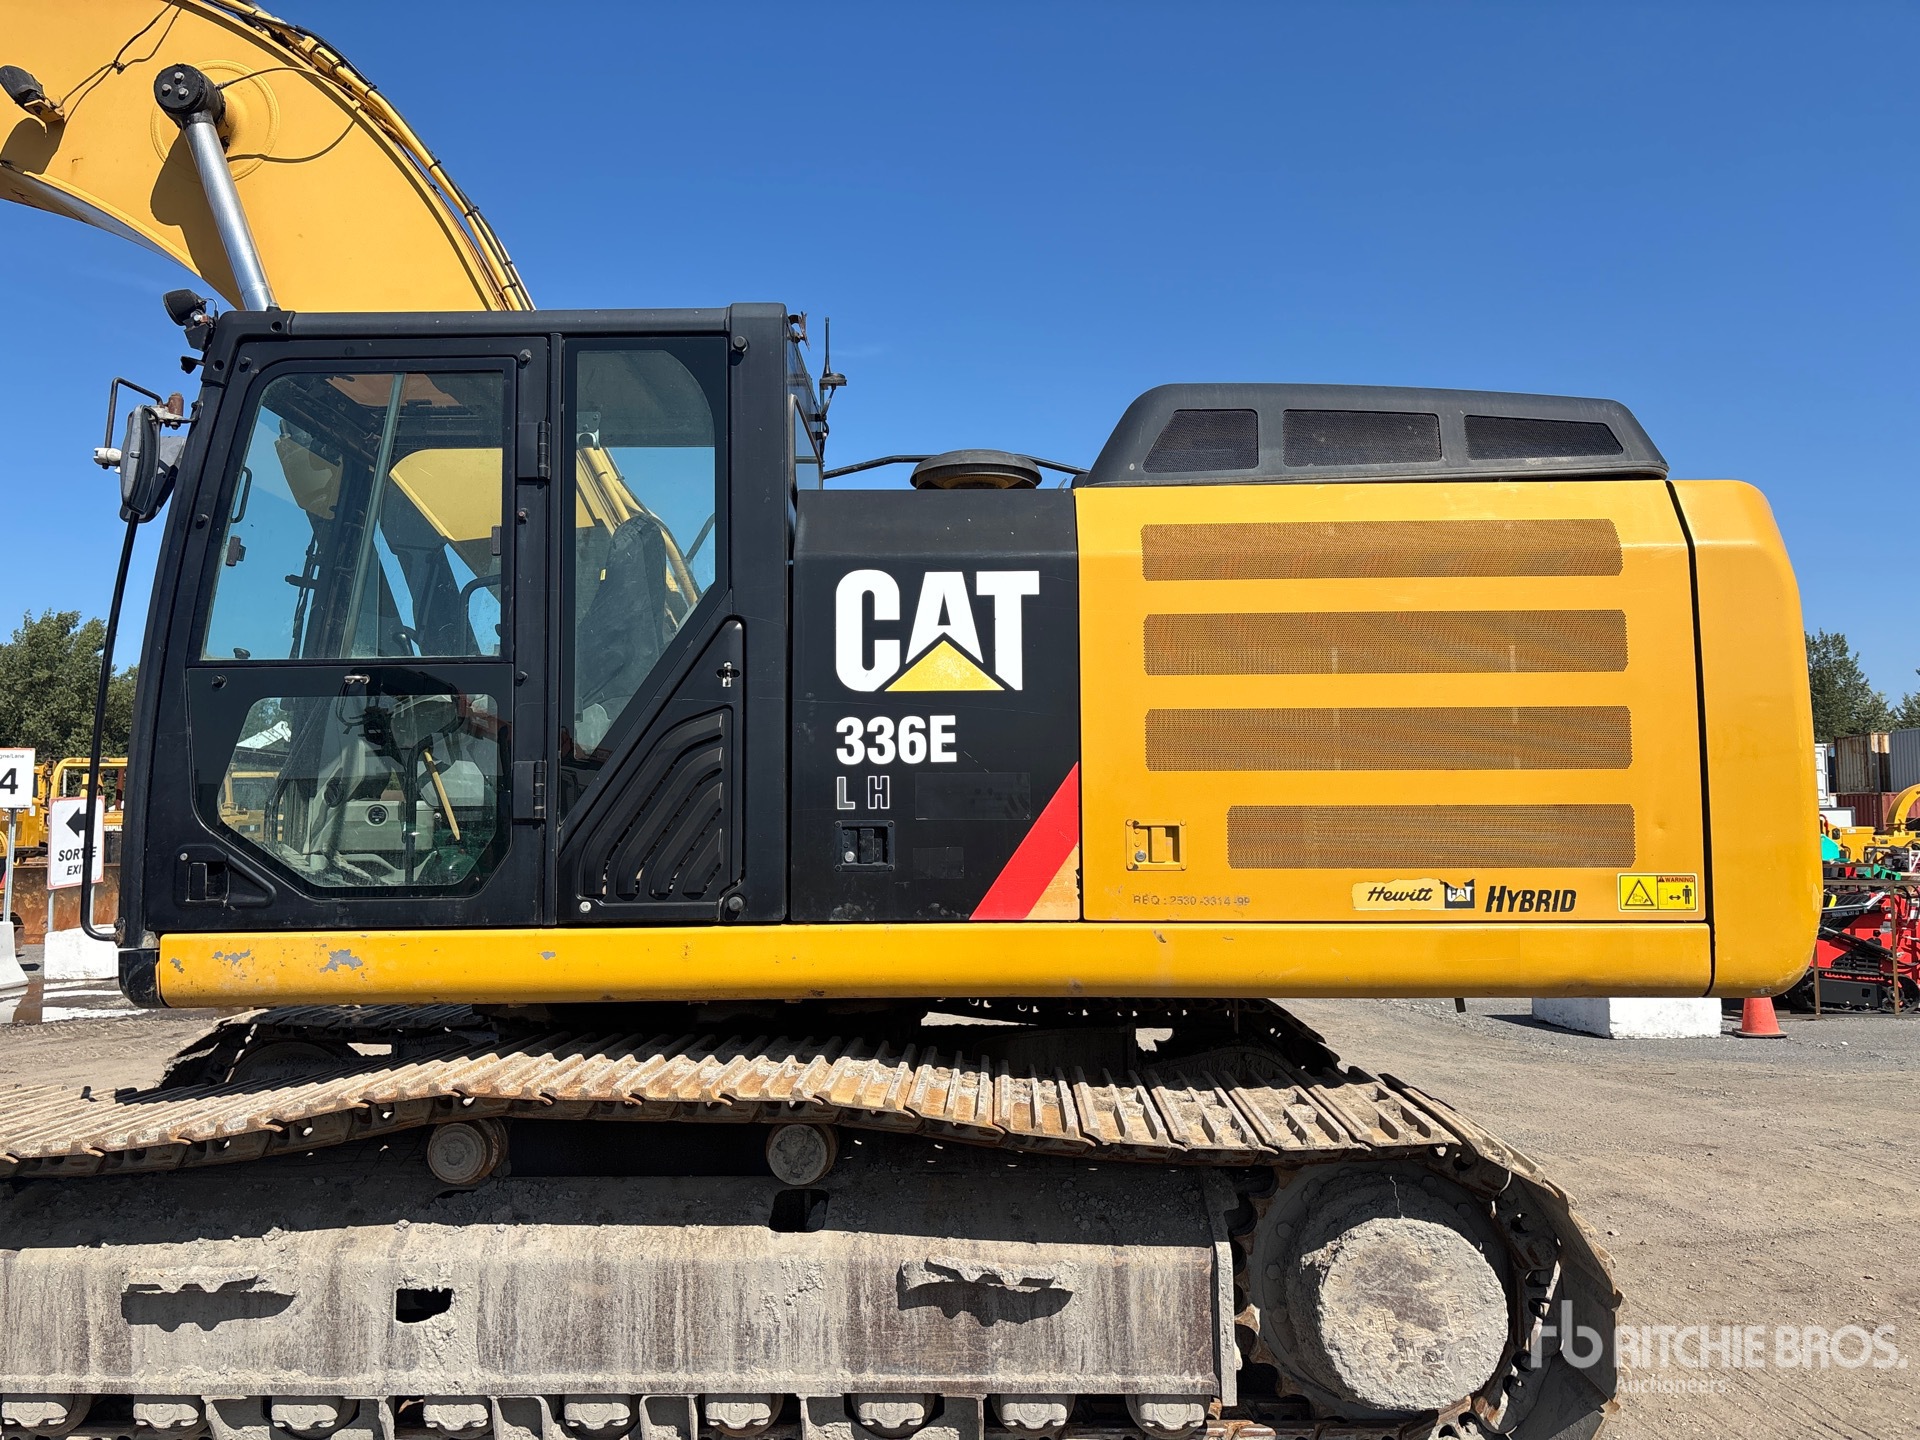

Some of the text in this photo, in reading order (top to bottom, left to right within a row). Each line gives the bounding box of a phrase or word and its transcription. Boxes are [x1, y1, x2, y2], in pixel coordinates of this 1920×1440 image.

[835, 569, 1040, 692] CAT
[836, 715, 957, 765] 336E
[0, 768, 18, 794] 4
[837, 775, 890, 810] L H
[58, 847, 97, 862] SORTE
[66, 864, 82, 875] EXI
[1367, 886, 1433, 902] Hewitt
[1447, 886, 1474, 902] CAT
[1485, 885, 1577, 912] HYBRID
